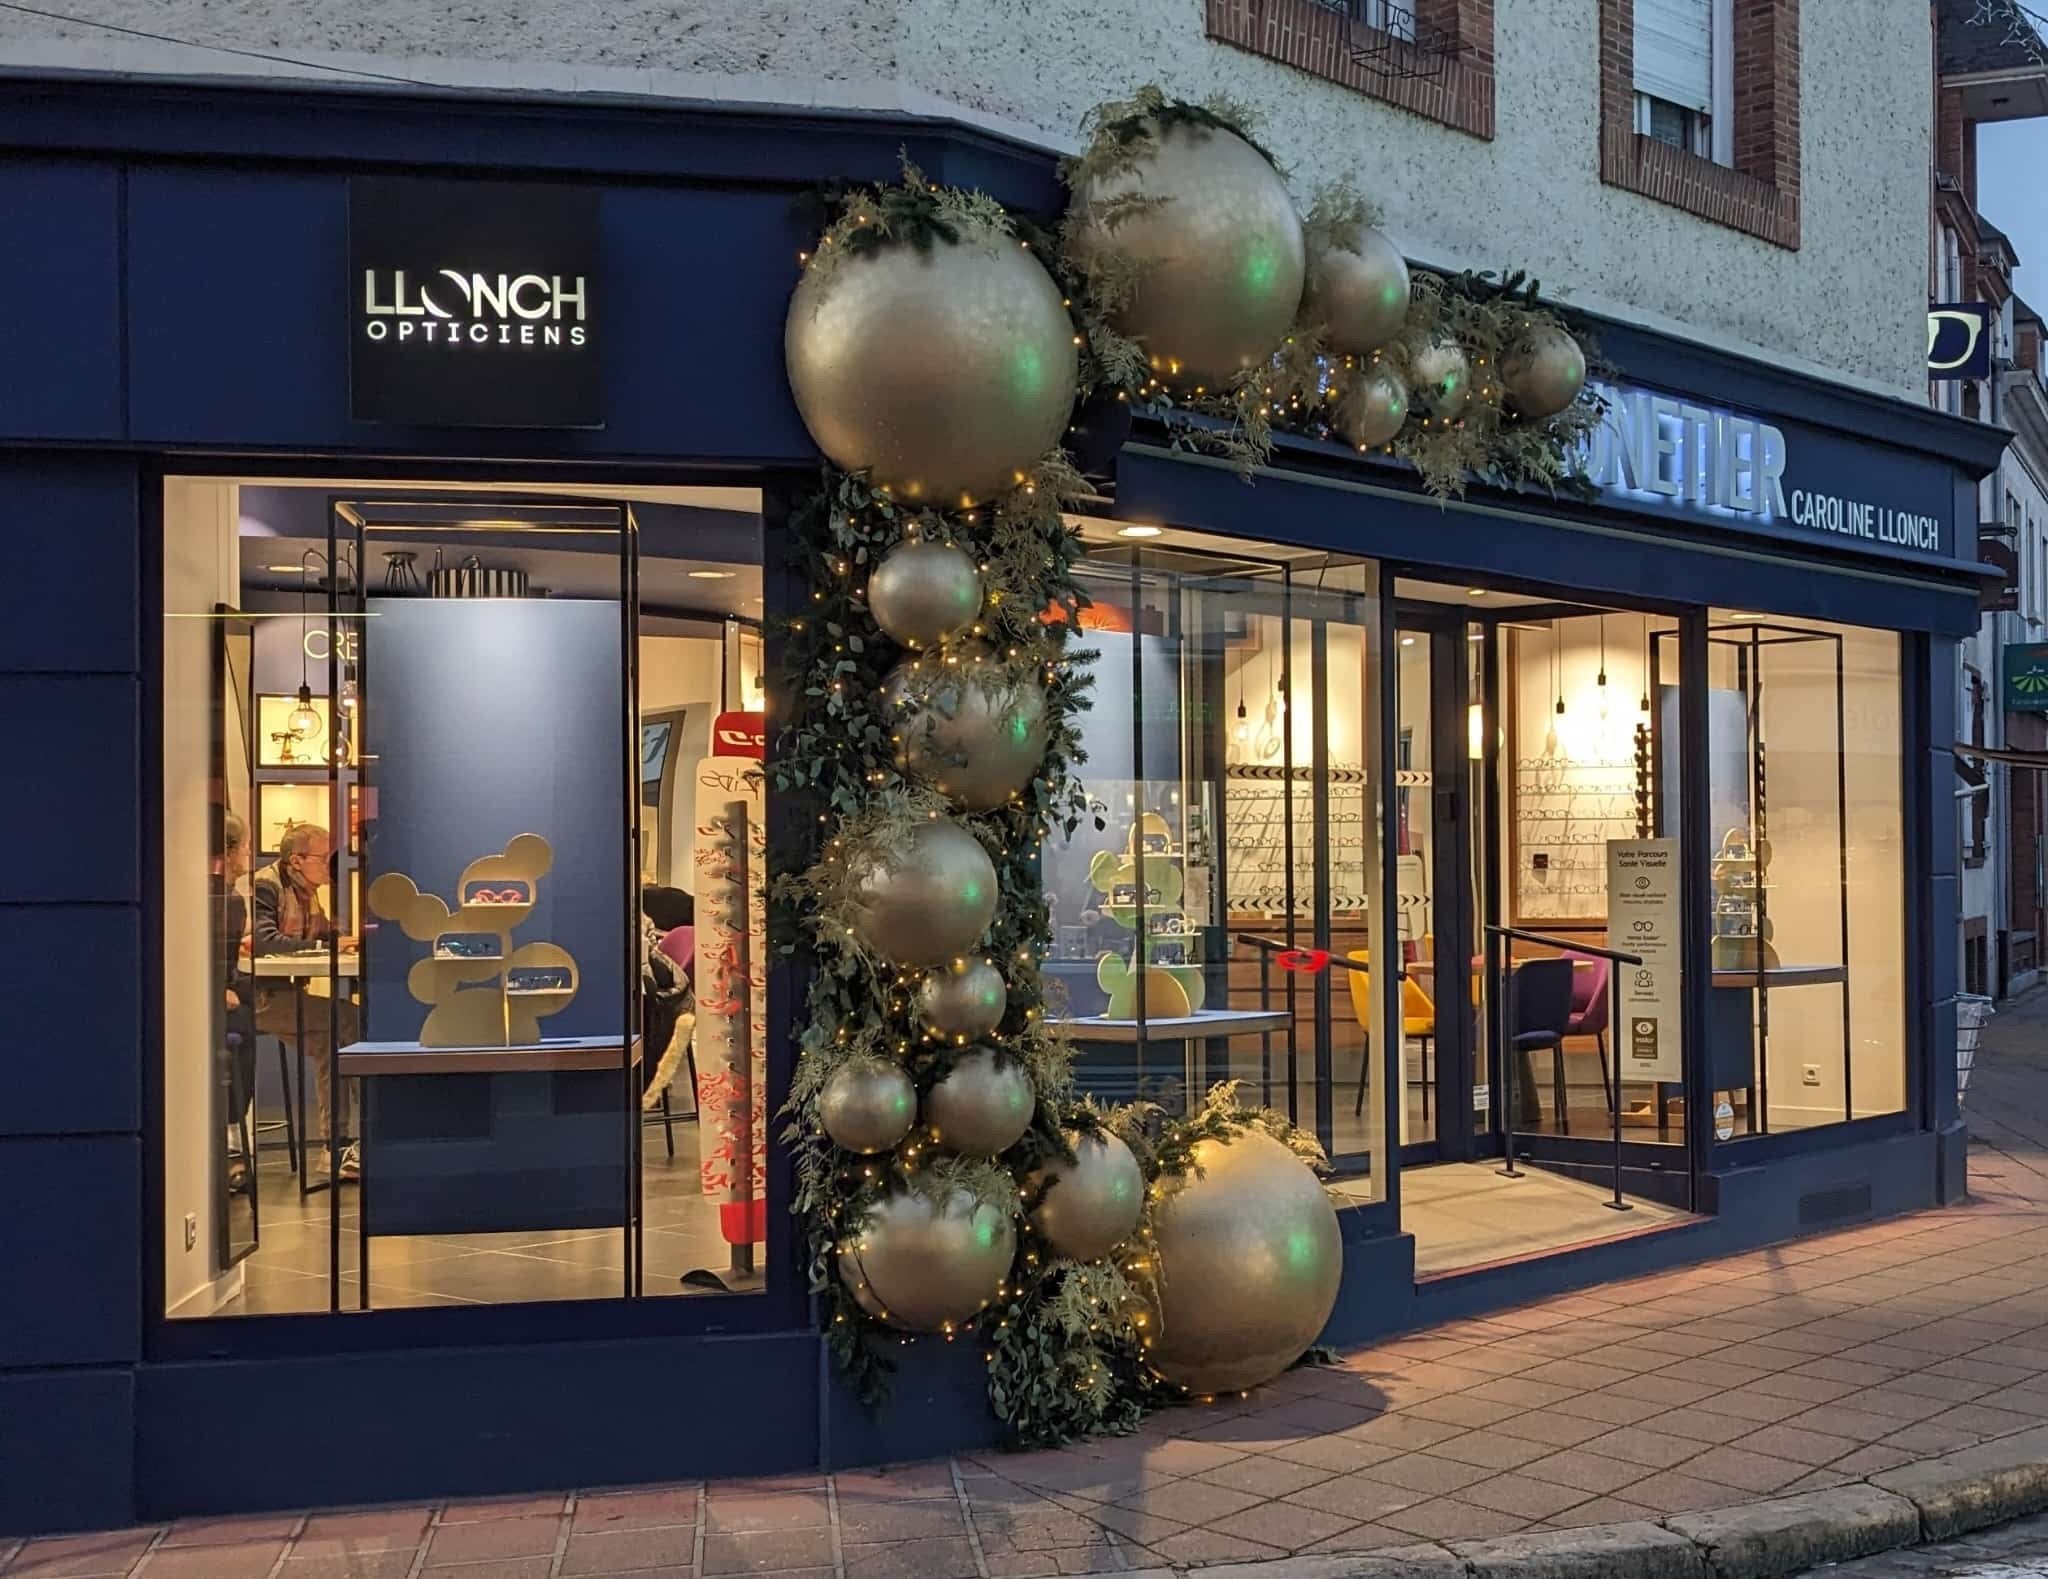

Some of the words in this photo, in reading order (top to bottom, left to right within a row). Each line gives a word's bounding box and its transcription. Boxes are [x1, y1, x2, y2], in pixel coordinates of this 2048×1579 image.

[366, 269, 585, 320] LLONCH
[367, 320, 585, 346] OPTICIENS
[1791, 489, 1875, 539] CAROLINE
[1878, 507, 1939, 551] LLONCH
